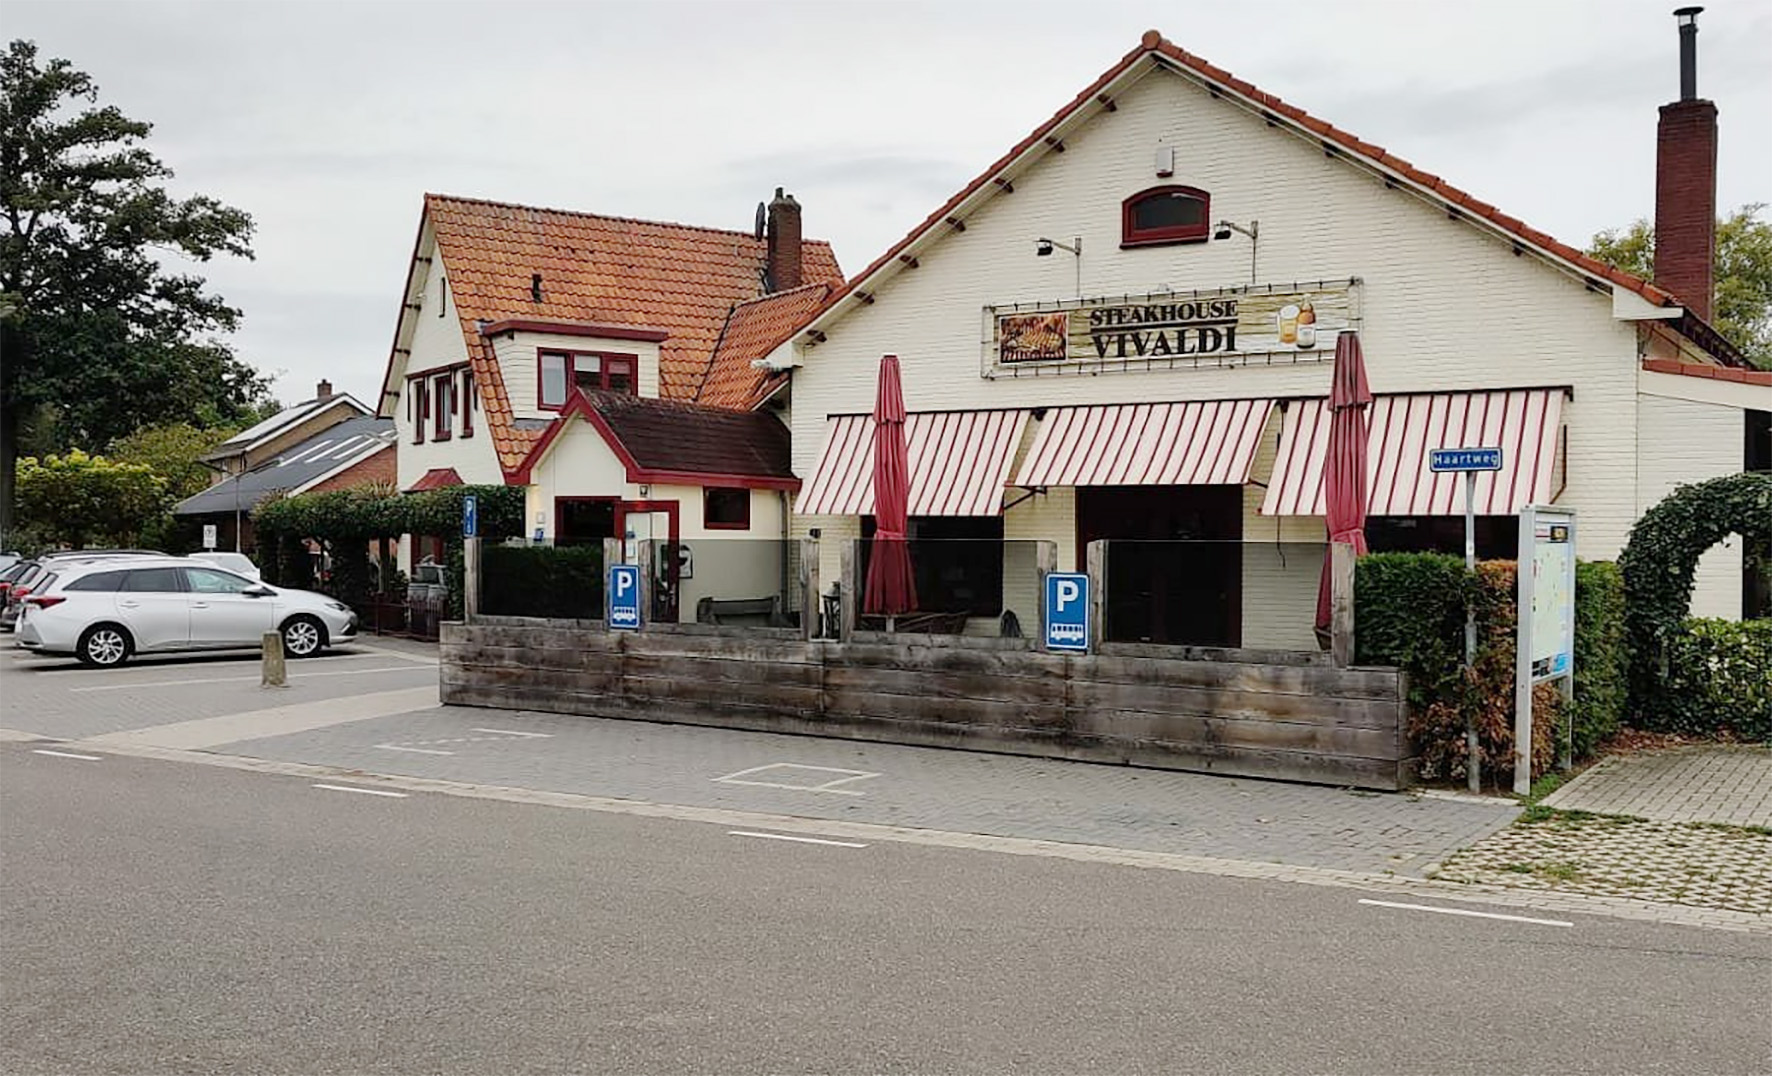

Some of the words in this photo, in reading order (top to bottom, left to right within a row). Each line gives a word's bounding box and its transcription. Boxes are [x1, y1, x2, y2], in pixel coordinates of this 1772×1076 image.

[1090, 299, 1239, 326] STEAKHOUSE
[1092, 326, 1237, 359] VIVALDI
[1433, 454, 1498, 466] Haartweg
[617, 571, 633, 598] P
[1057, 580, 1079, 612] P
